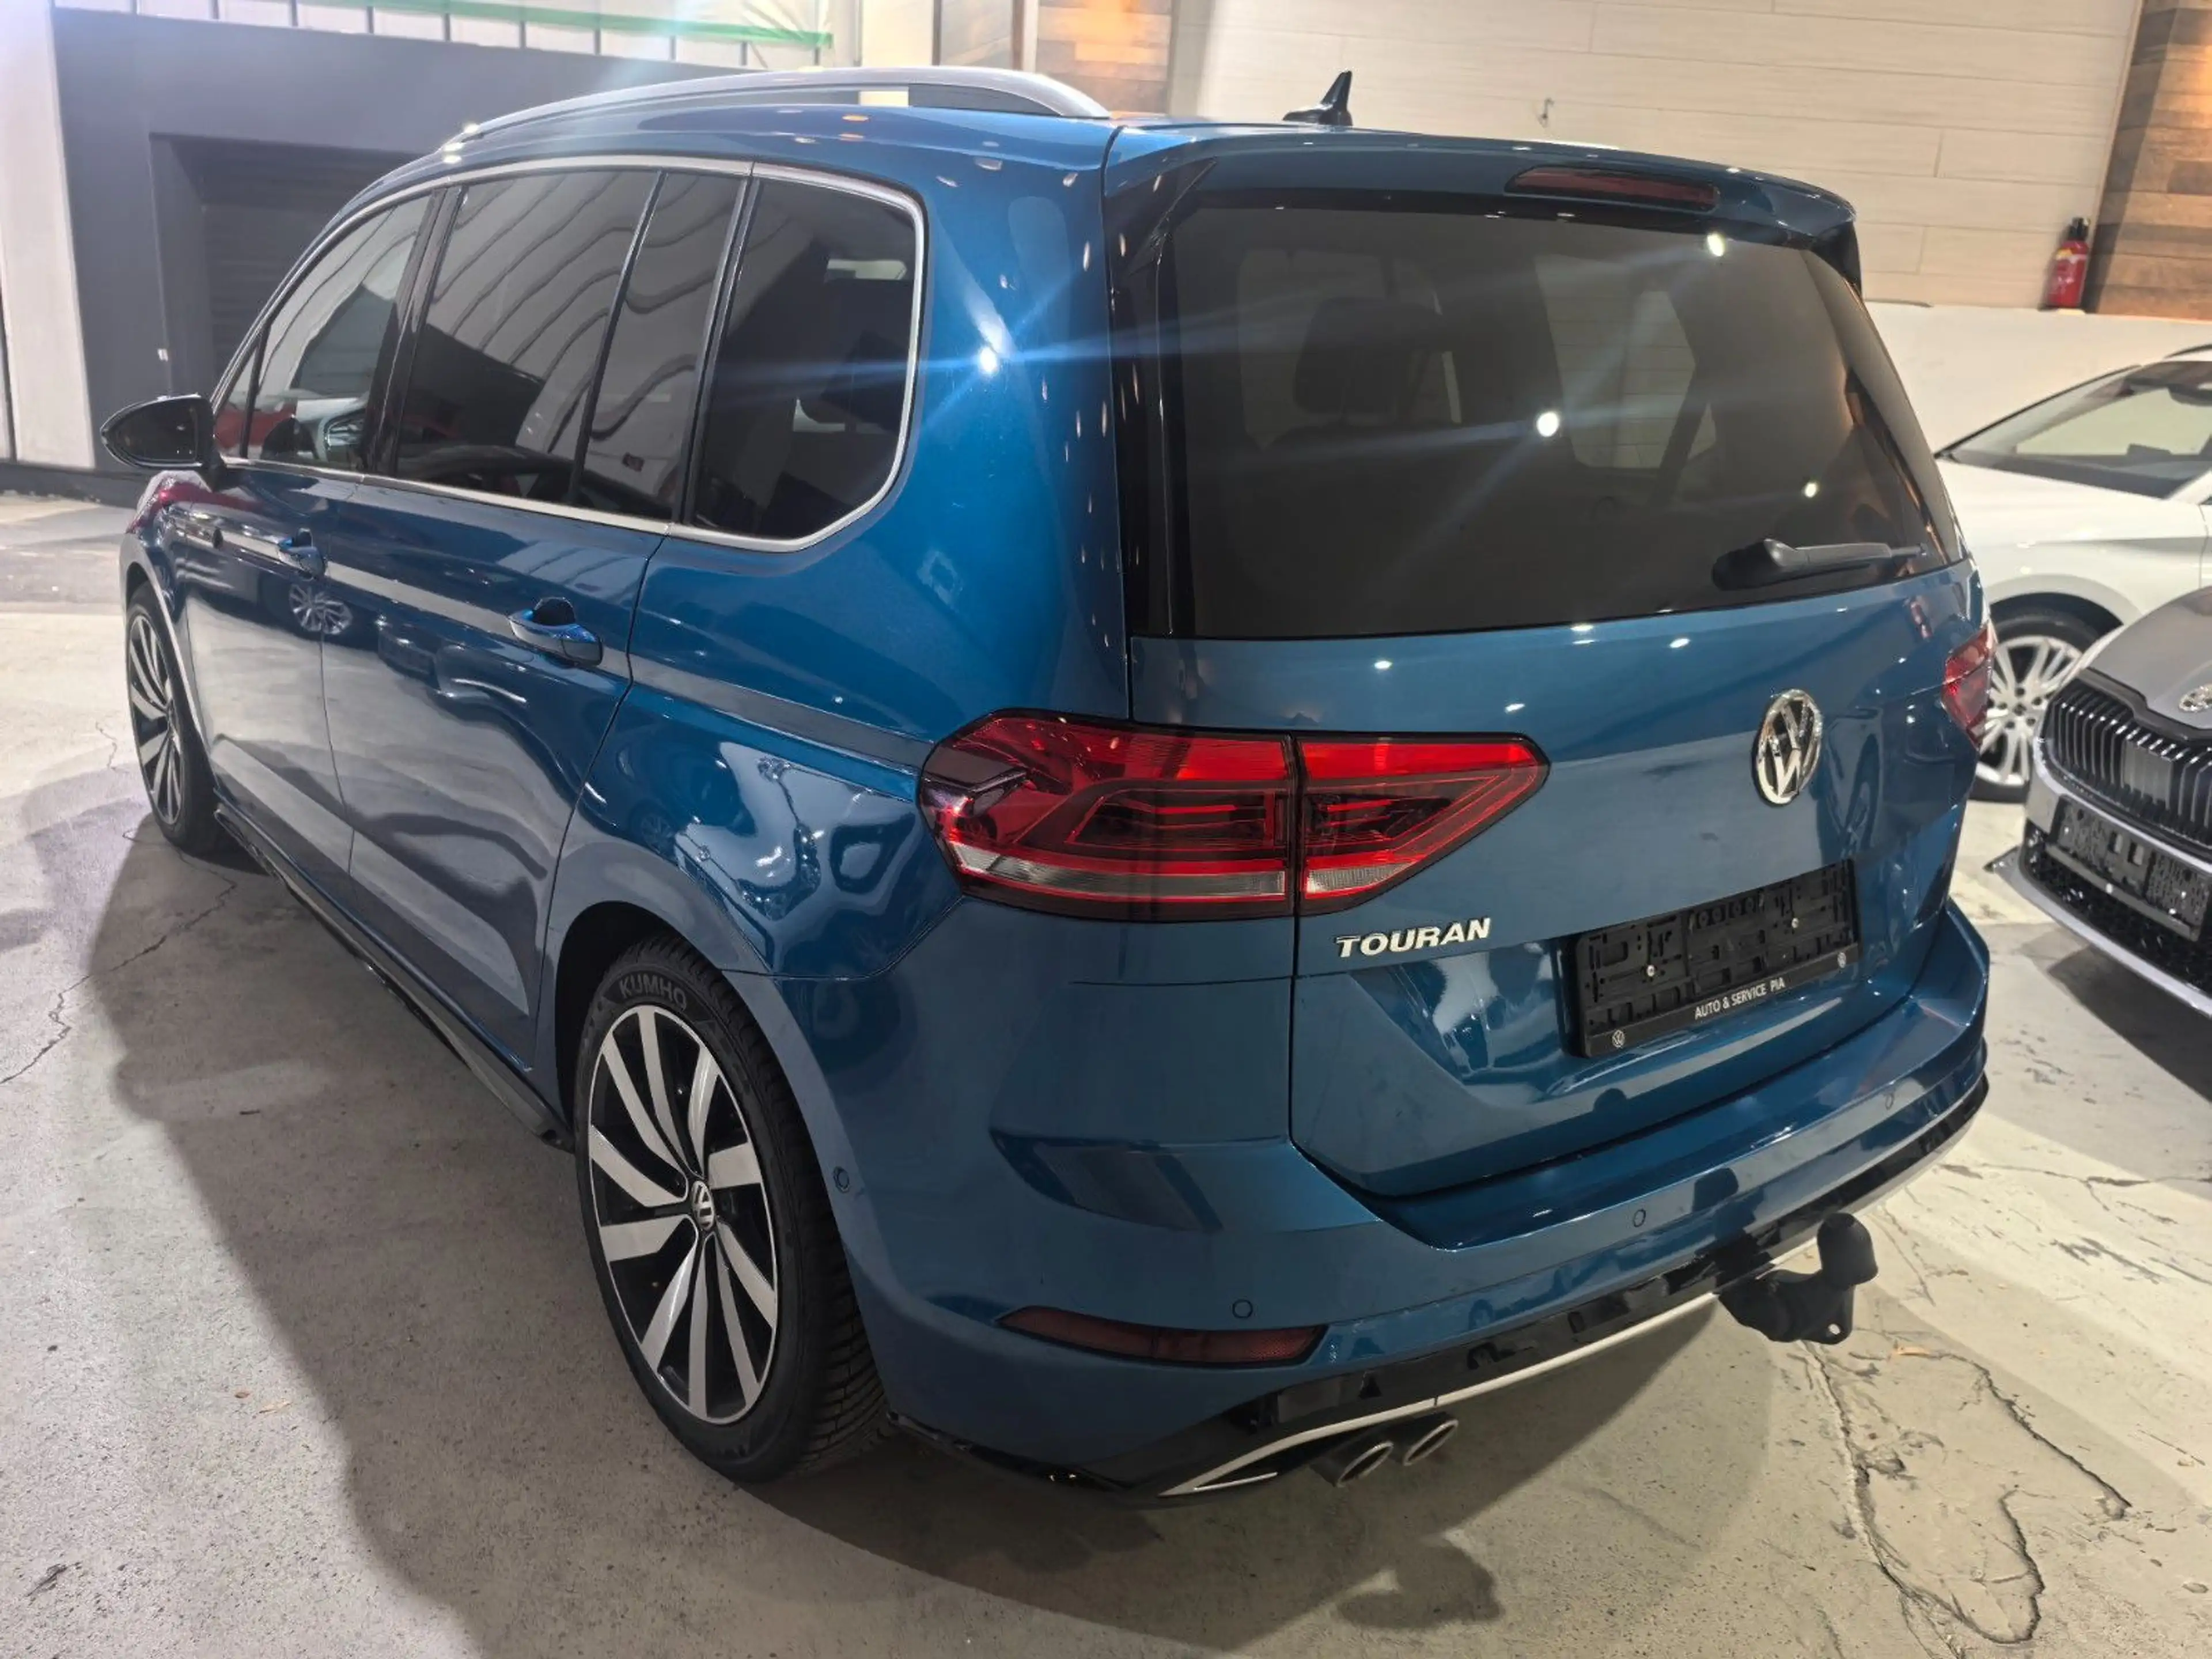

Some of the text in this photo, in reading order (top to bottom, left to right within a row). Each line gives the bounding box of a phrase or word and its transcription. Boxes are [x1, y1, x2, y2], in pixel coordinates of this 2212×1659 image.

[1335, 917, 1491, 959] TOURAN
[619, 973, 687, 1012] KUMHO
[1695, 999, 1721, 1020] AUTO
[1722, 997, 1730, 1009] &
[1731, 983, 1767, 1006] SERVICE
